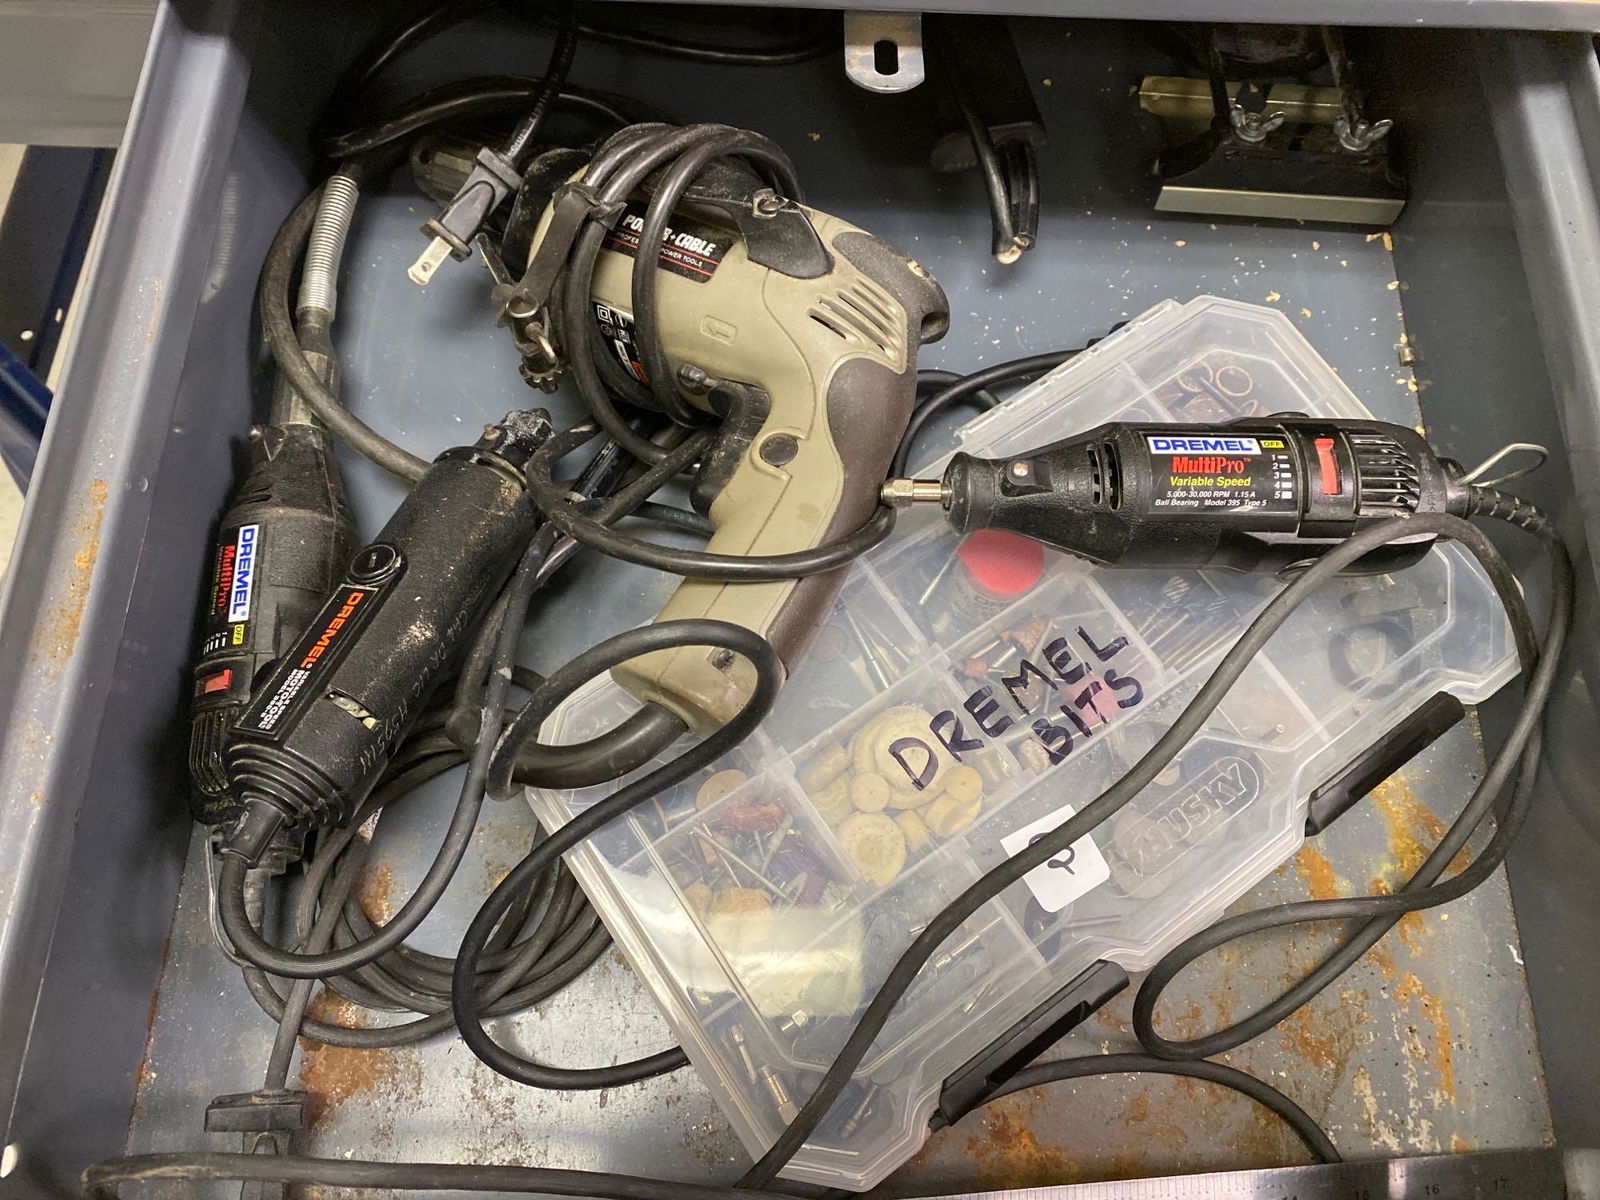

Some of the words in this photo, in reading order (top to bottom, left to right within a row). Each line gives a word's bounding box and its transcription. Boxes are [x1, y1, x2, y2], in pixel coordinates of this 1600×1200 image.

[682, 255, 703, 268] TOOLS
[1153, 440, 1253, 451] DREMEL
[1272, 462, 1279, 470] 2
[1170, 476, 1214, 486] Variable
[1216, 476, 1251, 488] Speed
[1274, 481, 1280, 489] 4
[1213, 490, 1230, 498] RPM
[1274, 490, 1280, 499] 5
[1155, 498, 1170, 506] Ball
[1170, 498, 1199, 508] Bearing
[1204, 499, 1226, 507] Model
[1227, 499, 1241, 507] 395
[1244, 499, 1261, 507] Type
[1261, 499, 1267, 507] 5
[232, 528, 254, 615] DREMEL
[235, 625, 243, 644] OFF
[300, 591, 364, 668] DREMEL
[277, 668, 298, 694] MODEL
[284, 670, 310, 704] VARIABLE
[888, 625, 1129, 791] DREMEL
[265, 705, 287, 730] SPEED
[1031, 669, 1144, 766] BITS
[1424, 1183, 1440, 1196] 16
